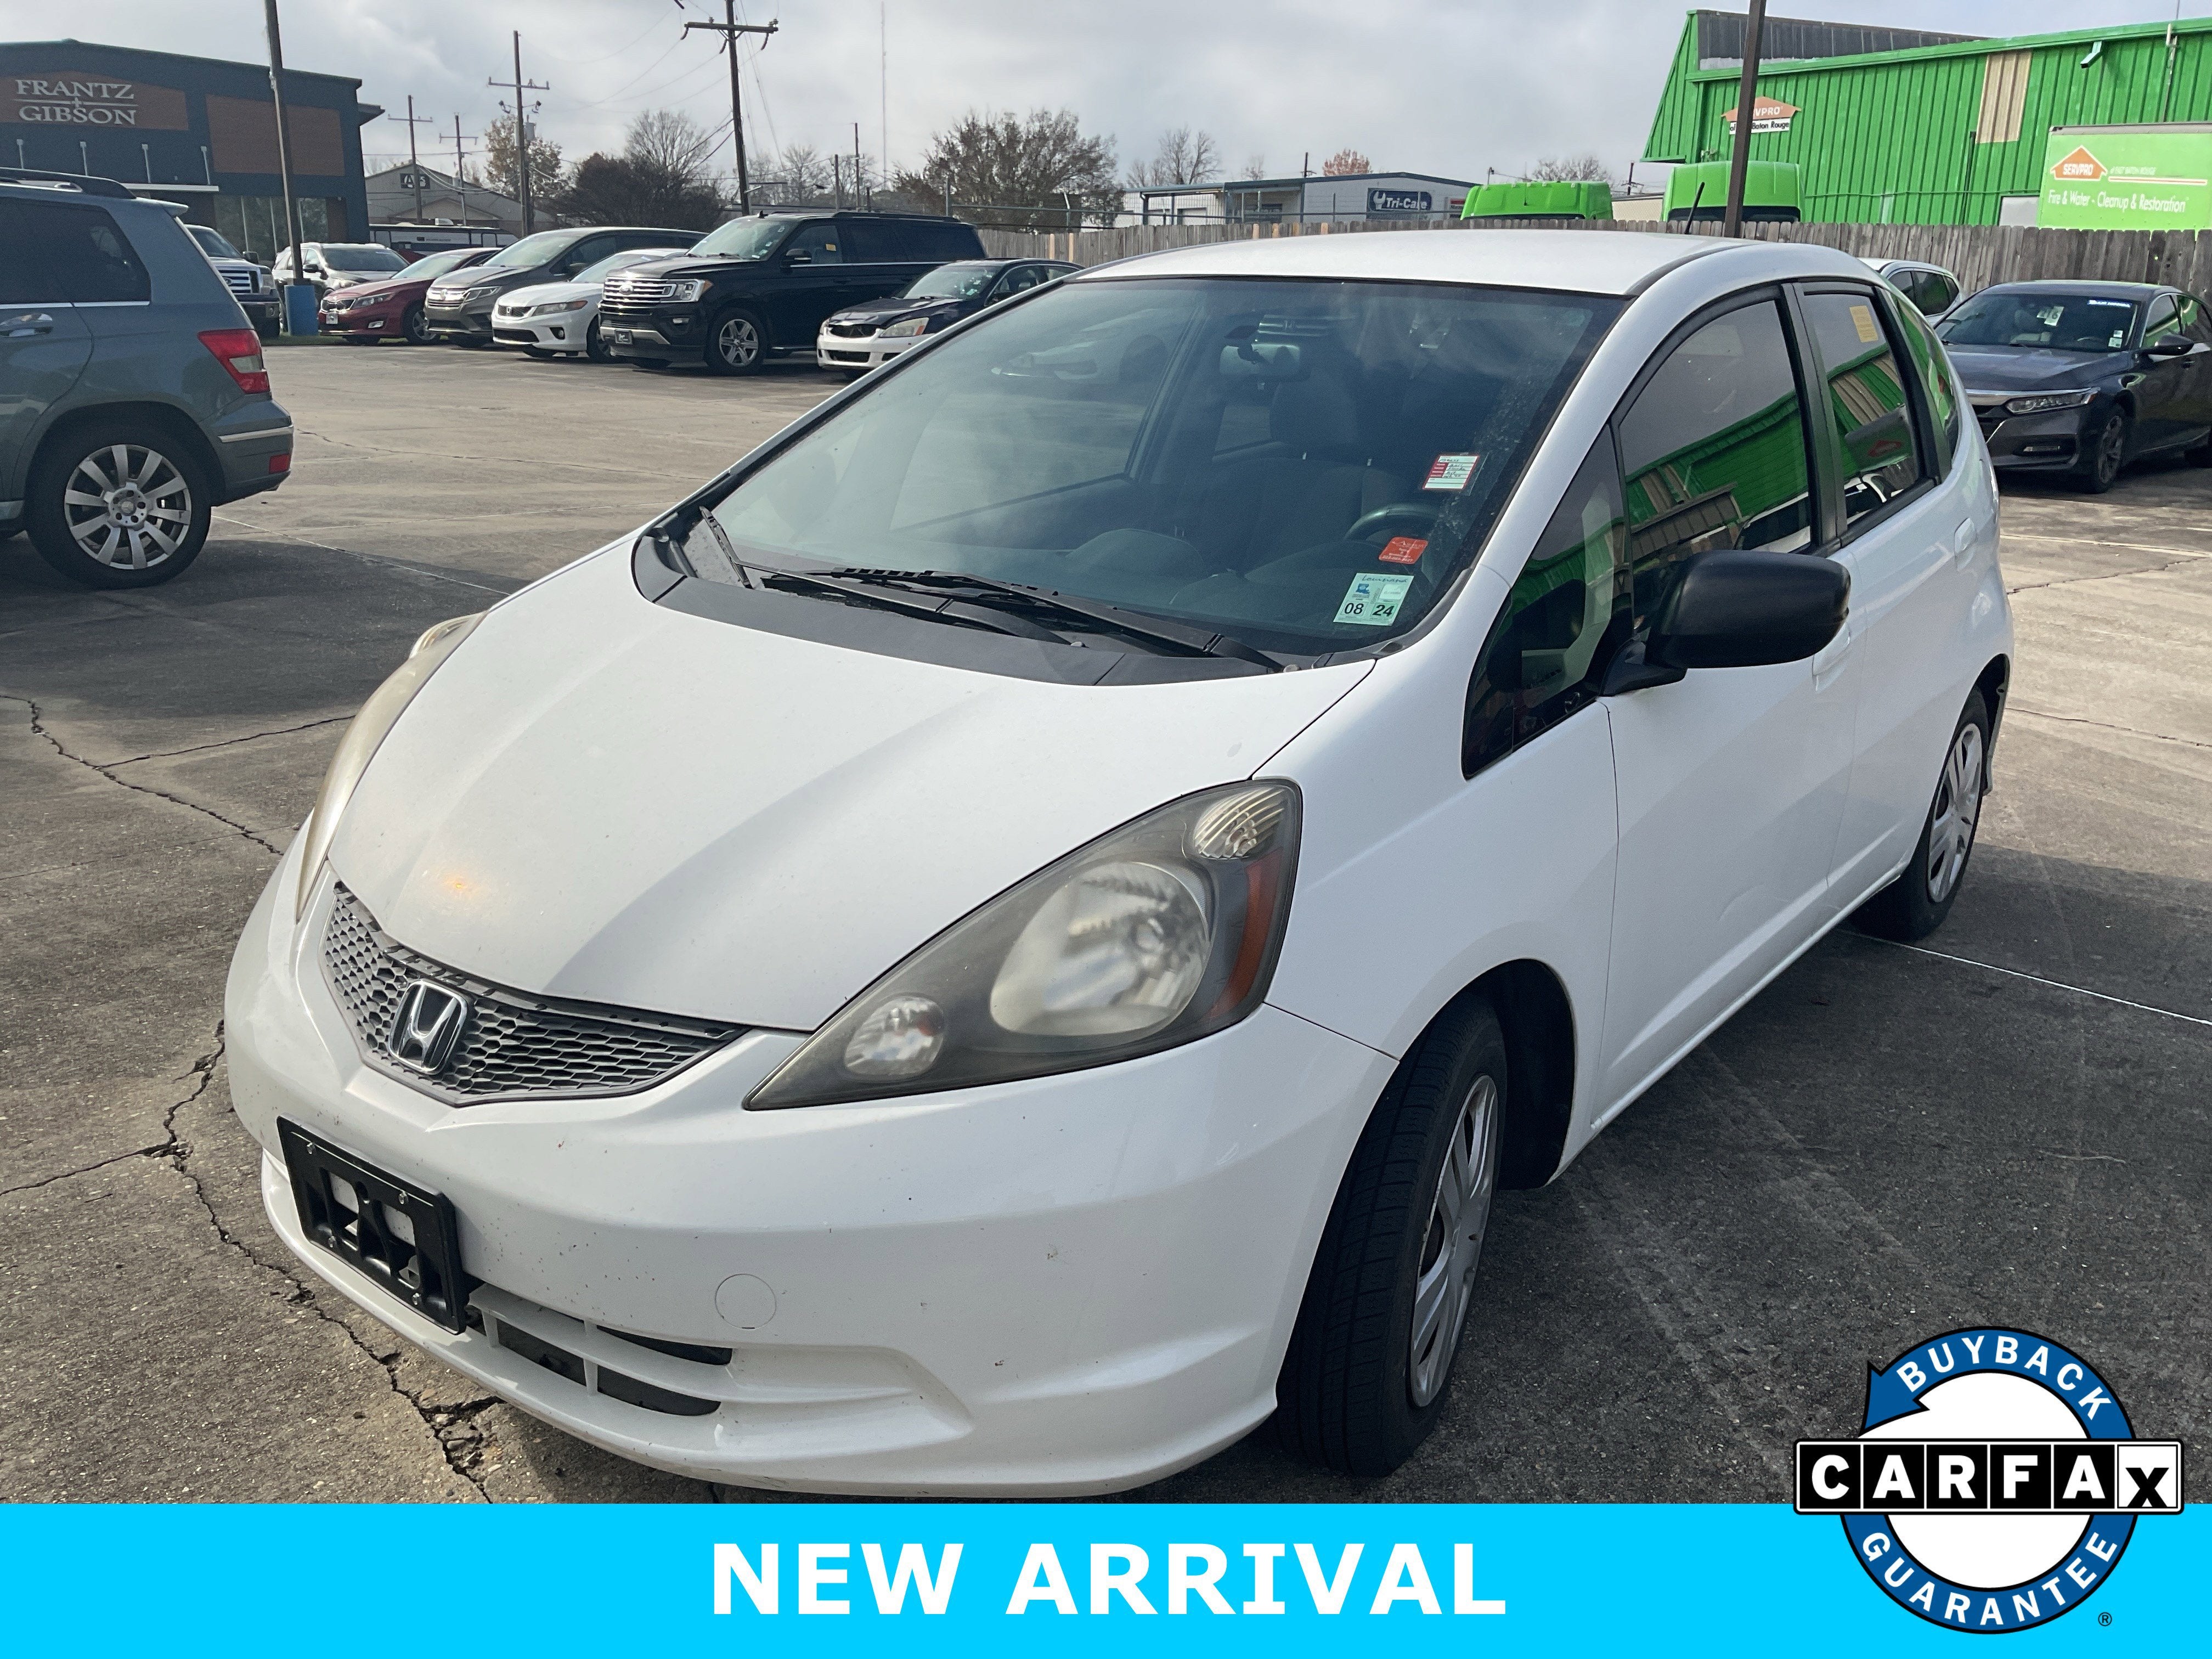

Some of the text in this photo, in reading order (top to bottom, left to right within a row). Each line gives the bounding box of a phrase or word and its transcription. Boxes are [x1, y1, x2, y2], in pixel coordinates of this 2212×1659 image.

[15, 80, 134, 99] FRANTZ
[18, 106, 136, 125] GIBSON
[1753, 106, 1780, 116] VPRO
[1771, 121, 1789, 129] Rouge
[2063, 163, 2094, 176] SERVPRO
[2049, 189, 2061, 205] Fire
[2062, 190, 2067, 205] &
[2069, 190, 2091, 206] Water
[2097, 191, 2128, 213] Cleanup
[2130, 193, 2136, 209] &
[2139, 194, 2186, 212] Restoration
[1344, 602, 1395, 617] 08 24
